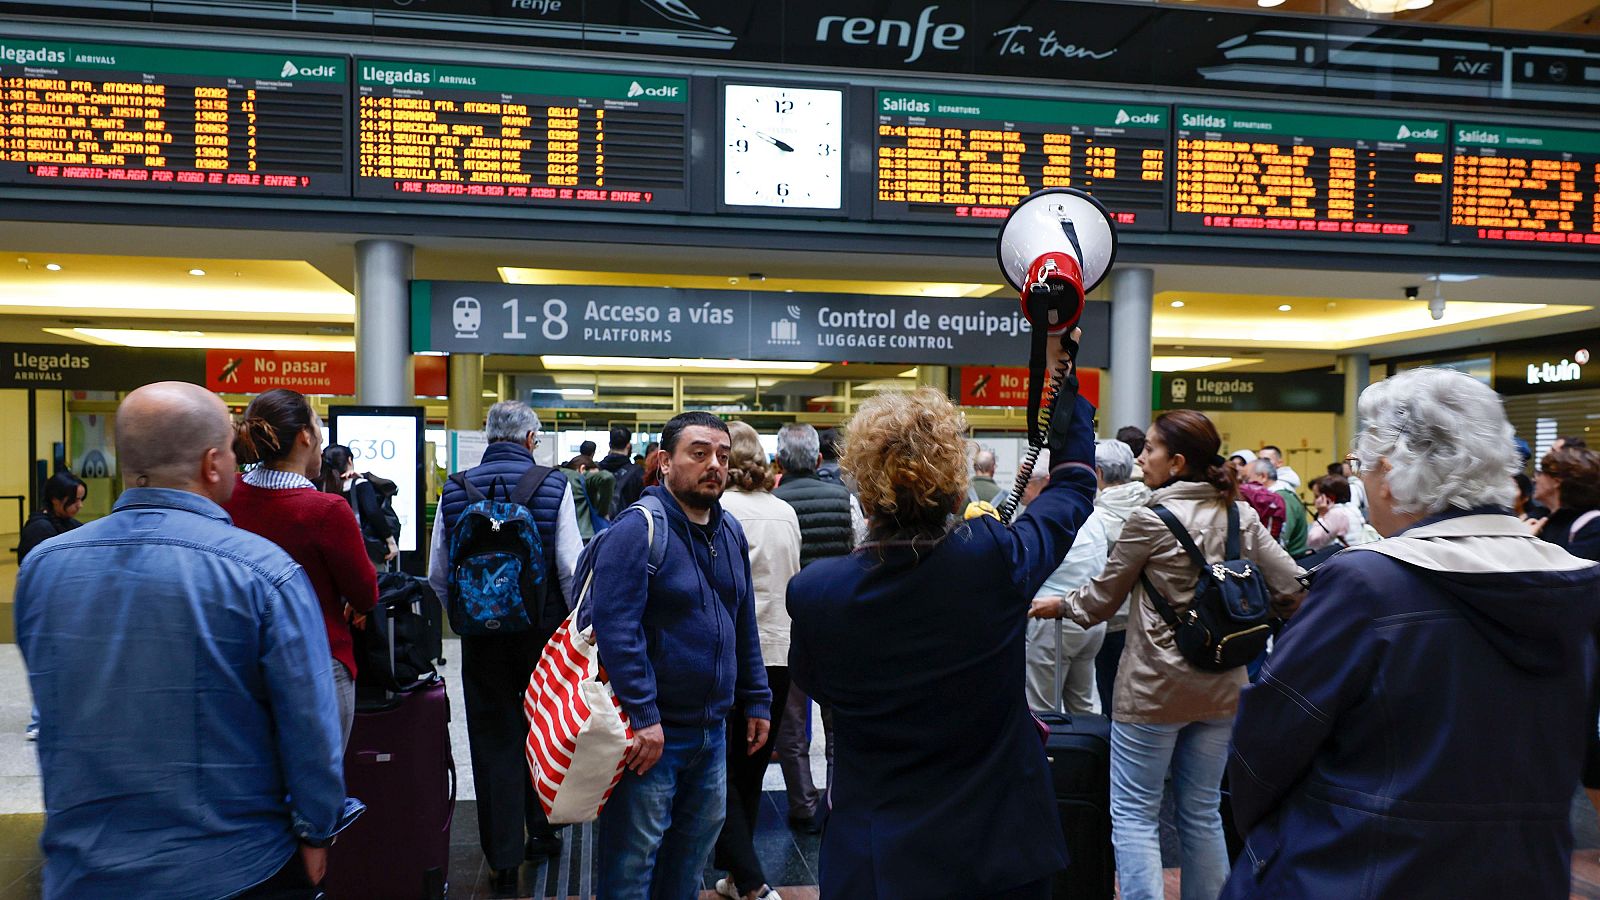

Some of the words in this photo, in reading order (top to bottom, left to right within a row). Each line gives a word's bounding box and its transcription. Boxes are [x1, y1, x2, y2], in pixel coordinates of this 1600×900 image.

[512, 0, 561, 15] renfe
[815, 5, 966, 63] renfe
[993, 25, 1033, 56] Tu
[1039, 30, 1117, 59] tren
[0, 45, 65, 64] legadas
[75, 54, 116, 65] ARRIVALS
[300, 65, 337, 77] adif
[363, 67, 431, 84] Llegadas
[439, 75, 477, 85] ARRIVALS
[1453, 61, 1492, 75] AVE
[0, 78, 23, 88] 1:12
[26, 79, 66, 90] MADRID
[71, 81, 96, 92] PTA.
[103, 83, 143, 94] ATOCHA
[144, 85, 164, 95] AVE
[248, 90, 255, 100] 5
[645, 86, 679, 97] adif
[0, 90, 24, 100] 1:30
[26, 91, 40, 101] EL
[45, 92, 143, 106] CHORRO-CAMINITO
[145, 97, 165, 107] PRX
[242, 102, 254, 112] 11
[360, 97, 392, 108] 14:42
[393, 98, 430, 110] MADRID
[435, 101, 458, 111] PTA.
[464, 103, 500, 114] ATOCHA
[503, 105, 526, 115] IRYO
[597, 110, 604, 118] 5
[775, 101, 794, 113] 12
[883, 98, 930, 113] Salidas
[938, 105, 981, 115] DEPARTURES
[0, 102, 24, 112] 1:47
[26, 103, 73, 114] SEVILLA
[78, 106, 103, 116] STA.
[110, 107, 143, 118] JUSTA
[145, 109, 159, 118] MD
[248, 114, 256, 123] 7
[393, 110, 436, 122] GRANADA
[502, 116, 531, 126] AVANT
[596, 121, 602, 130] 1
[1131, 113, 1161, 124] adif
[26, 115, 86, 127] BARCELONA
[91, 118, 124, 129] SANTS
[145, 121, 165, 131] AVE
[248, 126, 256, 135] 2
[361, 120, 391, 131] 14:54
[393, 122, 448, 134] BARCELONA
[452, 125, 483, 136] SANTS
[502, 128, 521, 137] AVE
[596, 133, 603, 141] 4
[1183, 114, 1226, 128] Salidas
[1233, 121, 1273, 130] DEPARTURES
[26, 128, 67, 139] MADRID
[72, 130, 97, 140] PTA.
[104, 131, 143, 141] ATOCHA
[145, 133, 172, 143] AVLO
[248, 138, 256, 147] 4
[361, 132, 391, 143] 15:11
[393, 133, 436, 145] SEVILLA
[440, 136, 464, 146] STA.
[470, 137, 500, 148] JUSTA
[502, 139, 531, 149] AVANT
[597, 144, 602, 152] 1
[1411, 129, 1439, 139] adif
[1459, 130, 1500, 144] Salidas
[27, 140, 73, 151] SEVILLA
[78, 142, 104, 152] STA.
[110, 143, 144, 154] JUSTA
[145, 145, 159, 154] MD
[248, 149, 256, 158] 7
[360, 143, 392, 154] 15:22
[393, 145, 430, 156] MADRID
[434, 147, 458, 157] PTA.
[464, 149, 500, 159] ATOCHA
[502, 150, 520, 160] AVE
[548, 153, 578, 163] 02122
[596, 155, 603, 164] 2
[736, 139, 749, 152] 9
[818, 144, 829, 156] 3
[27, 152, 86, 164] BARCELONA
[91, 154, 124, 165] SANTS
[145, 157, 165, 166] AVE
[248, 161, 256, 171] 3
[393, 156, 430, 168] MADRID
[434, 159, 458, 169] PTA.
[464, 160, 500, 171] ATOCHA
[502, 162, 520, 172] AVE
[548, 164, 578, 174] 02142
[596, 166, 603, 175] 2
[37, 166, 58, 176] AVE
[63, 167, 148, 180] MADRID-MALAGA
[152, 171, 174, 181] POR
[177, 172, 205, 182] ROBO
[208, 173, 223, 183] DE
[227, 174, 260, 185] CABLE
[264, 175, 297, 186] ENTRE
[393, 168, 436, 180] SEVILLA
[440, 170, 464, 181] STA.
[470, 172, 500, 182] JUSTA
[502, 174, 531, 183] AVANT
[597, 178, 603, 186] 4
[402, 182, 422, 192] AVE
[426, 183, 504, 196] MADRID-MALAGA
[508, 187, 527, 197] POR
[531, 188, 556, 198] ROBO
[560, 189, 573, 199] DE
[577, 190, 607, 200] CABLE
[611, 192, 641, 202] ENTRE
[777, 183, 789, 196] 6
[502, 298, 569, 340] 1-8
[584, 301, 660, 323] Acceso
[667, 307, 681, 323] a
[689, 302, 734, 325] vías
[818, 307, 896, 329] Control
[904, 310, 930, 330] de
[584, 328, 672, 342] PLATFORMS
[817, 334, 886, 348] LUGGAGE
[890, 335, 954, 349] CONTROL
[14, 353, 90, 370] Llegadas
[254, 357, 276, 373] No
[282, 360, 327, 375] pasar
[15, 371, 63, 381] ARRIVALS
[1527, 359, 1581, 384] k-tuin
[254, 376, 265, 385] NO
[266, 377, 330, 386] TRESPASSING
[1000, 374, 1019, 388] No
[1196, 379, 1254, 395] Llegadas
[1000, 391, 1012, 399] NO
[1196, 395, 1233, 404] ARRIVALS
[348, 439, 396, 460] 630
